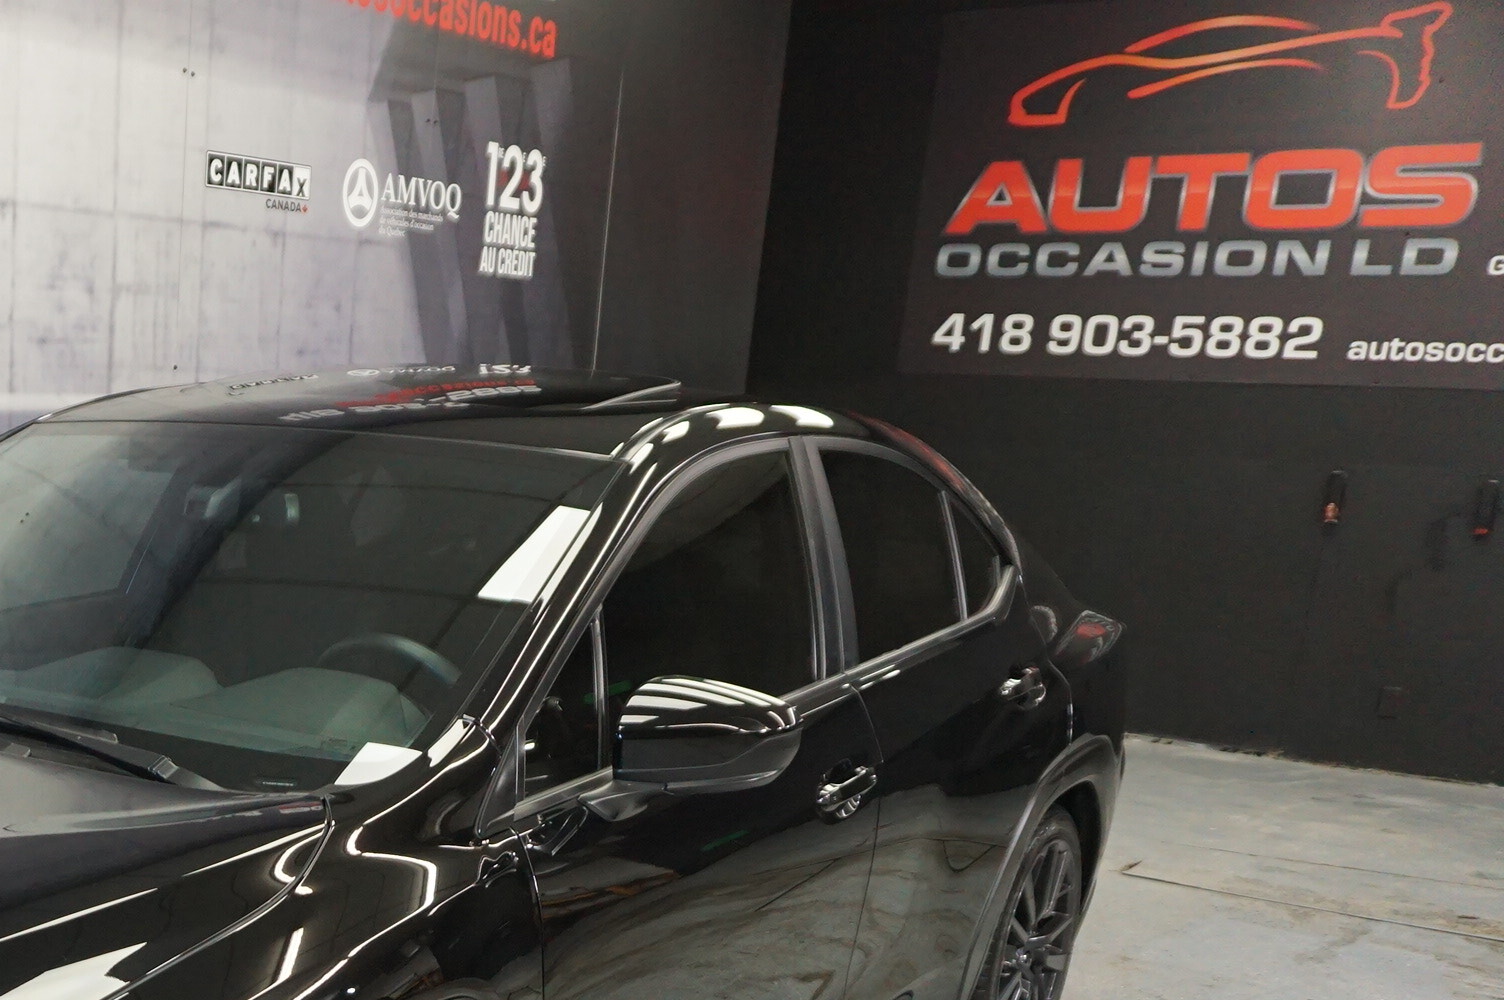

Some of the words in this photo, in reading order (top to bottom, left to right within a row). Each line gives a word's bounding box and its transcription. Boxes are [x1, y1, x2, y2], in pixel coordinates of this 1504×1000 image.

[209, 157, 308, 198] CARFAX
[381, 172, 462, 219] AMVOQ
[944, 142, 1483, 234] AUTOS
[265, 198, 302, 213] CANADA
[485, 211, 537, 249] CHANCE
[479, 246, 496, 273] AU
[934, 239, 1332, 278] OCCASION
[1349, 238, 1460, 277] LD
[931, 313, 1034, 355] 418
[1046, 314, 1324, 360] 903-5882
